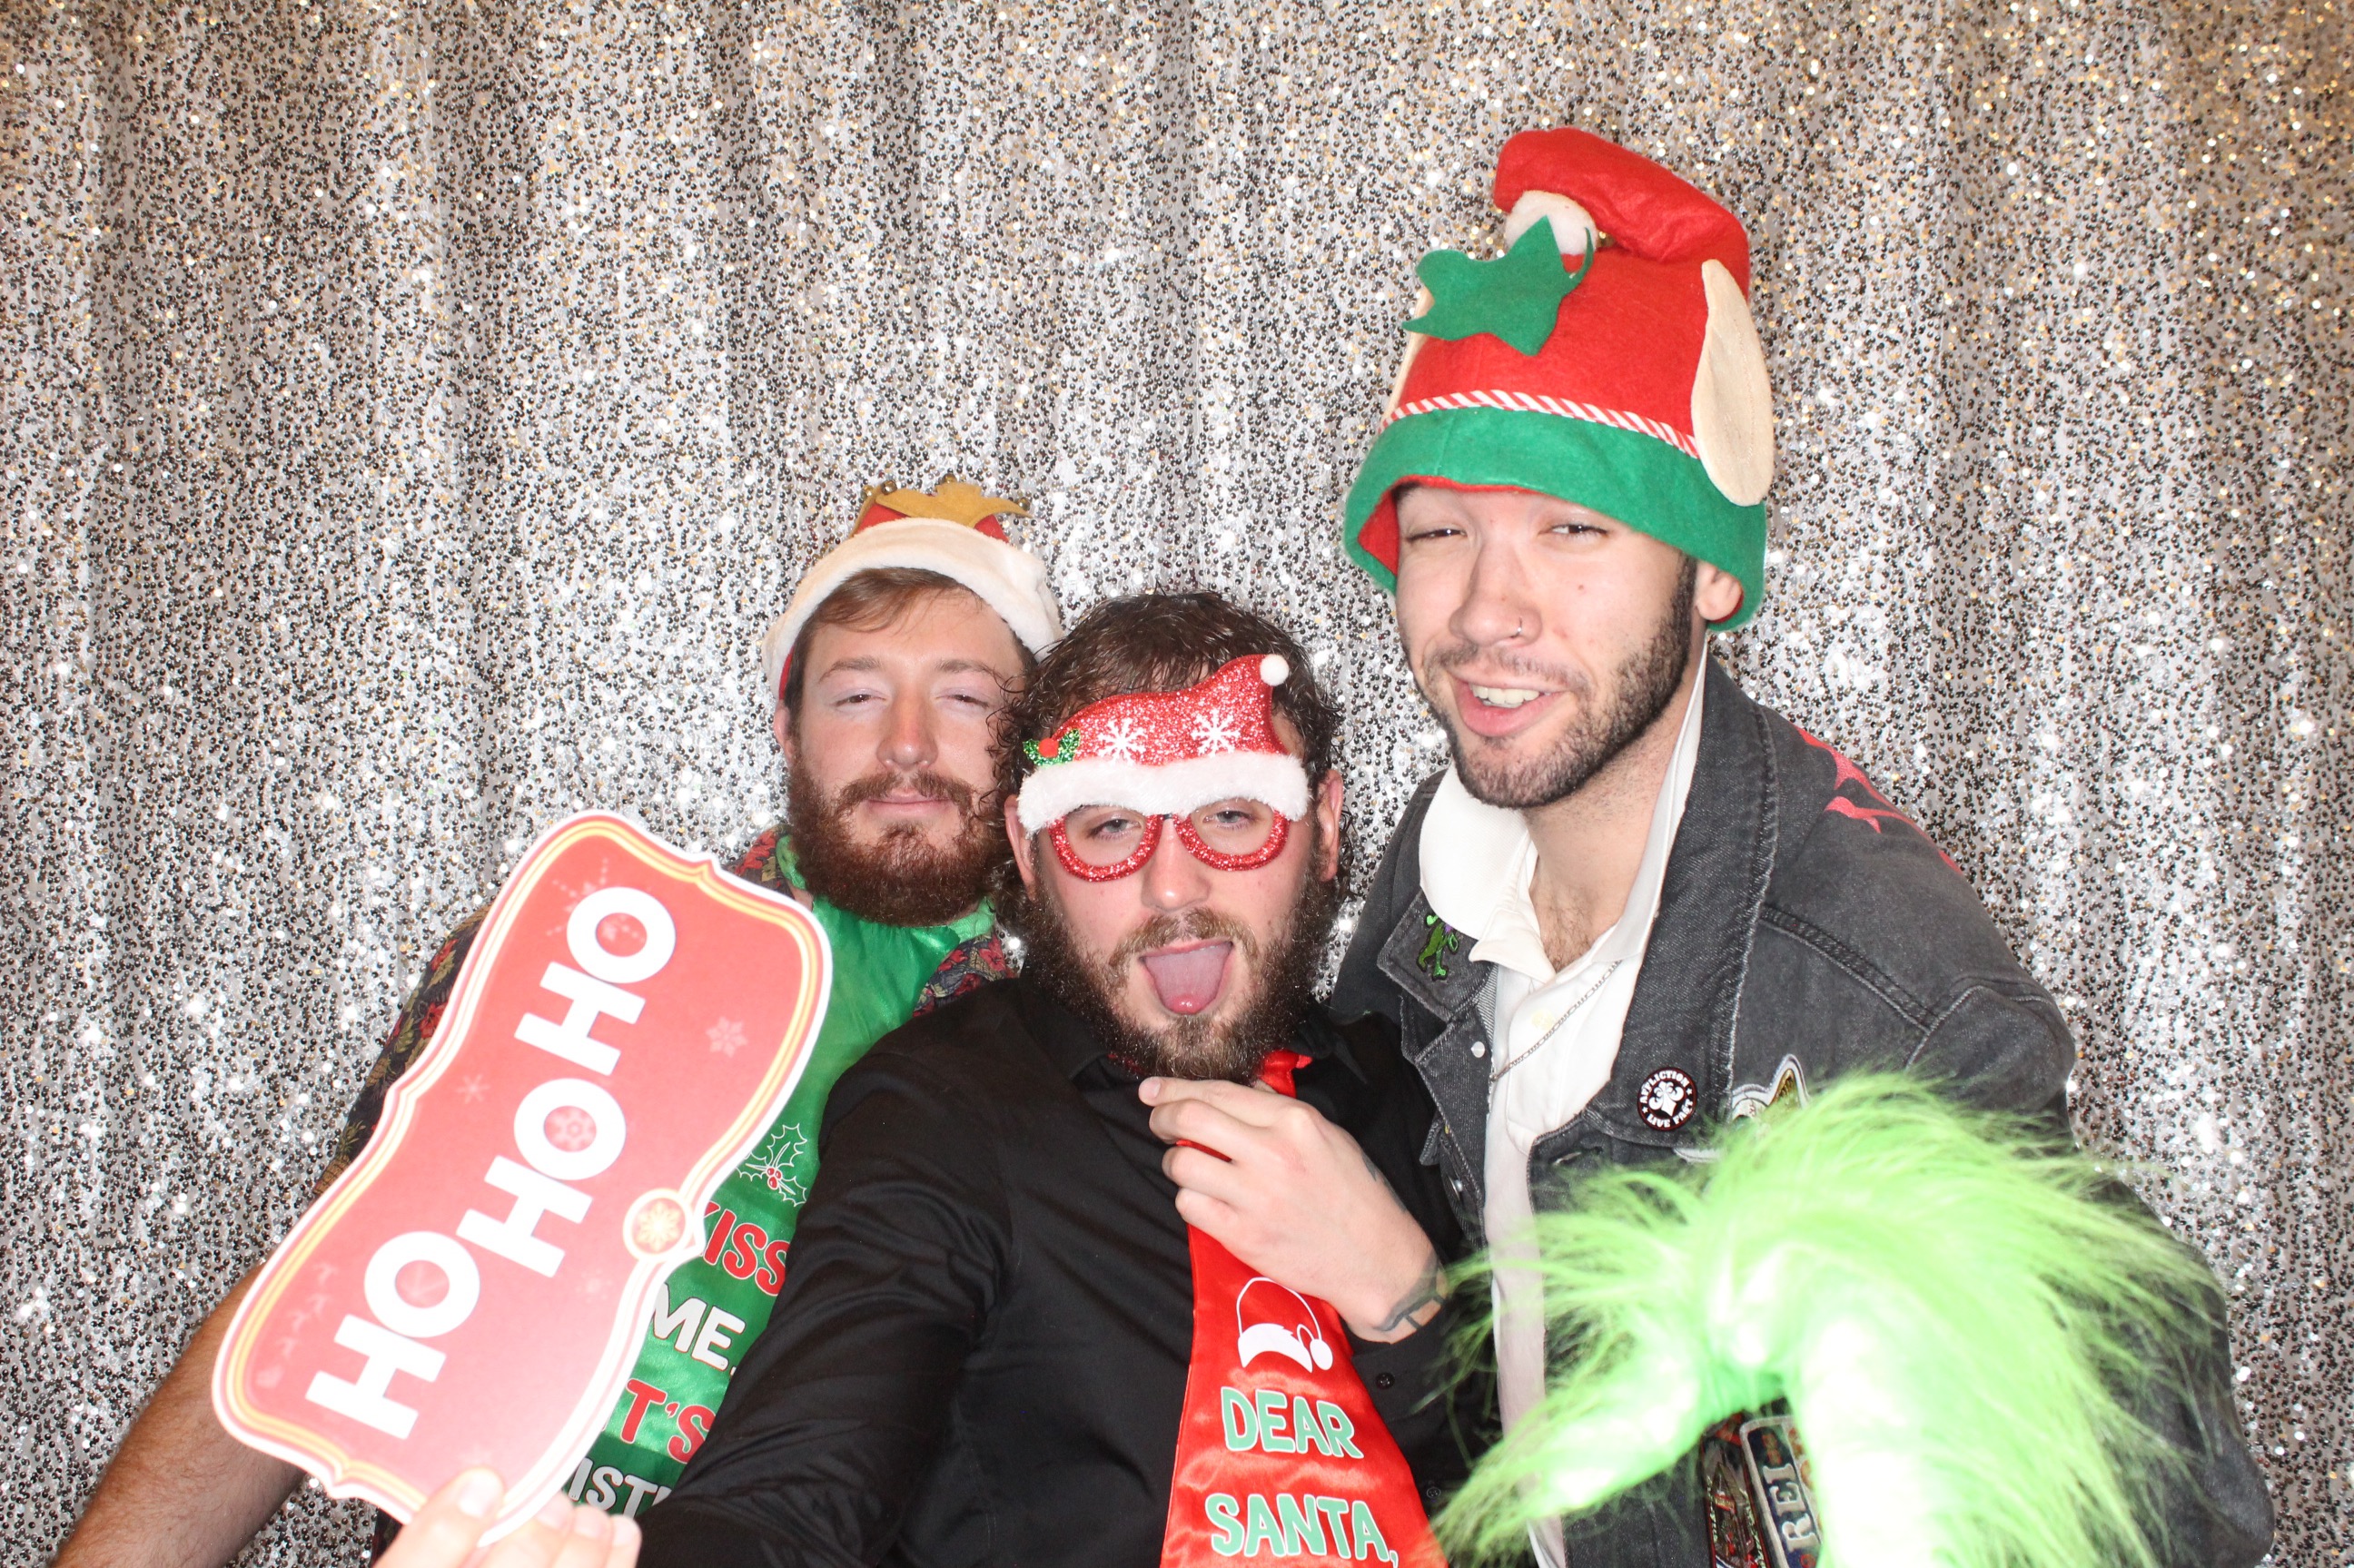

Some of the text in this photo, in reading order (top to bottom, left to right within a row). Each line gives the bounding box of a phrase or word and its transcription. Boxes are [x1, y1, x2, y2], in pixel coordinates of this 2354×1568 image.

[1639, 1070, 1690, 1104] AFFLICTION
[1647, 1099, 1694, 1128] LIVE FAST
[305, 886, 677, 1440] HOHOHO
[603, 1378, 716, 1464] T'S
[1221, 1386, 1364, 1459] DEAR
[1204, 1494, 1399, 1568] SANTA,
